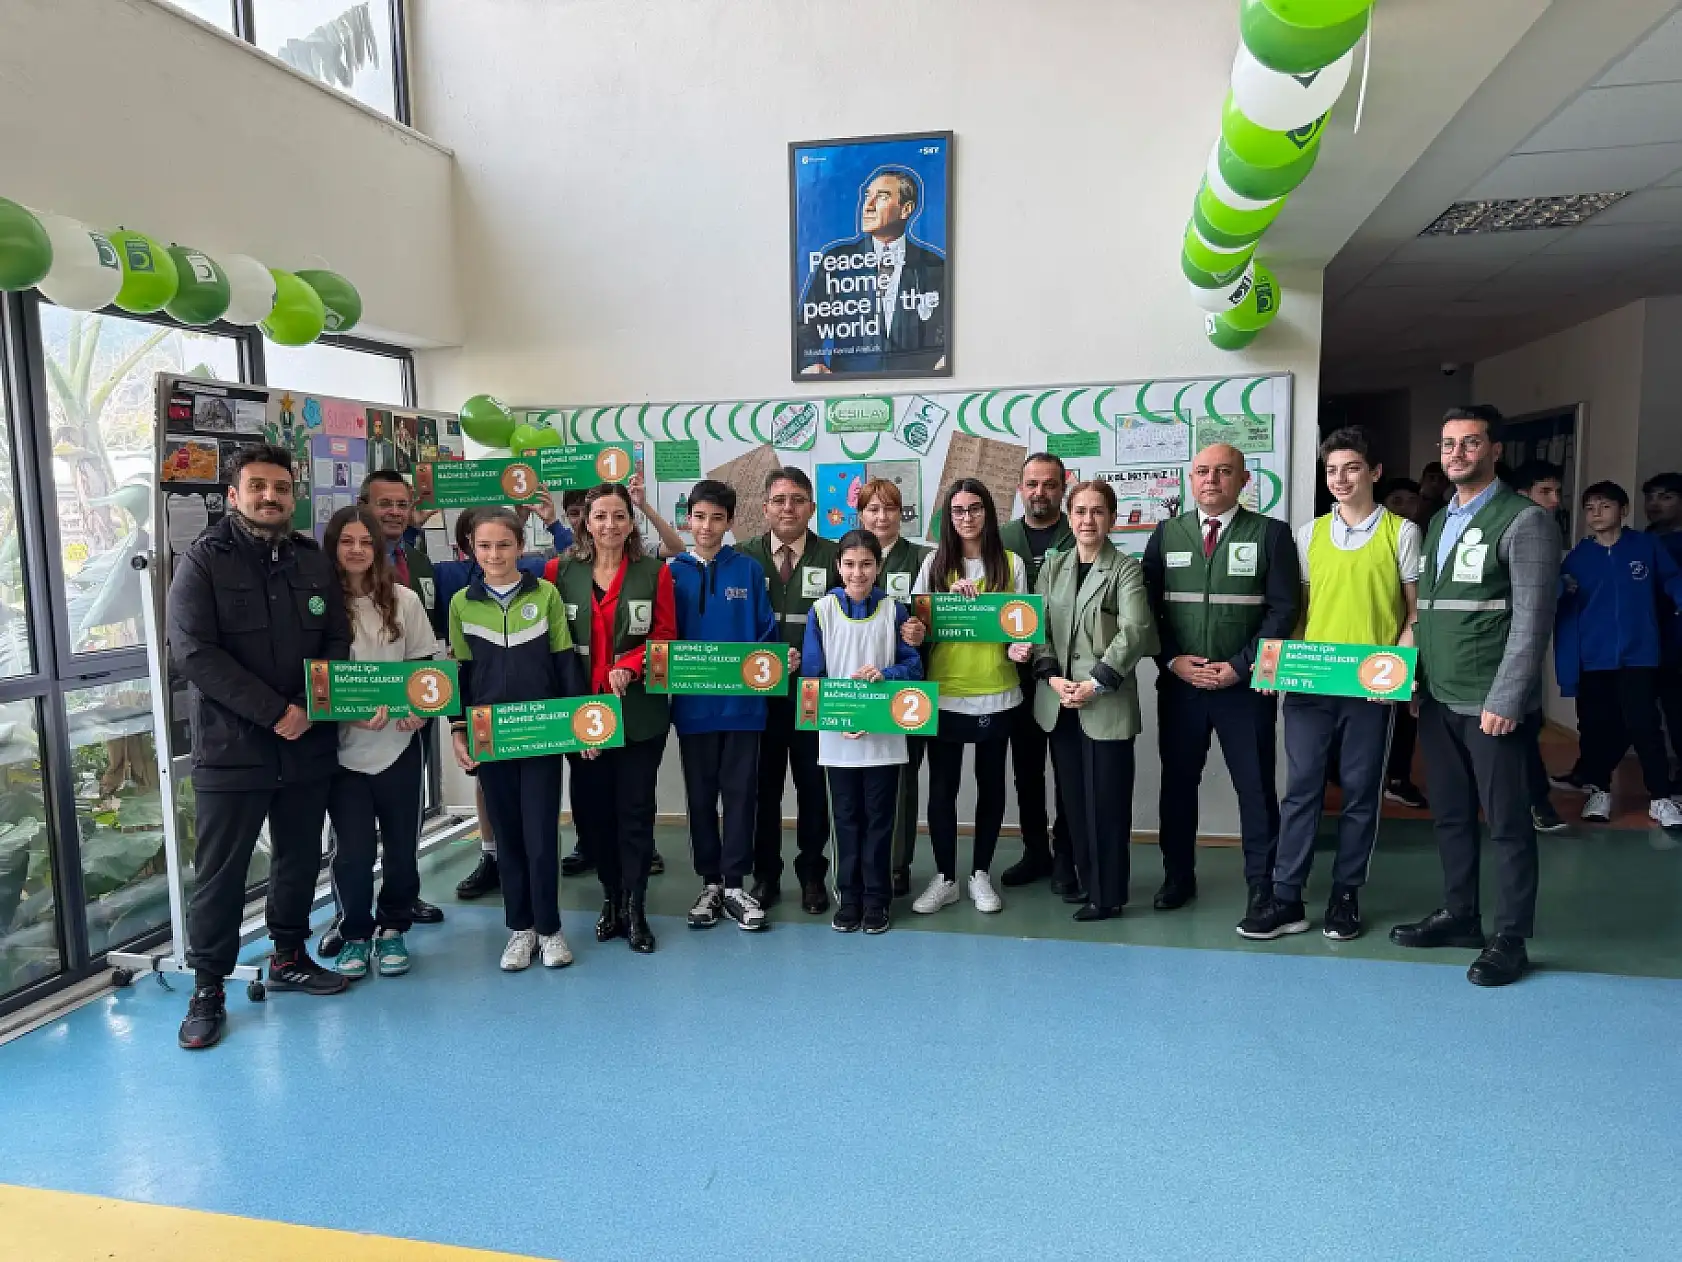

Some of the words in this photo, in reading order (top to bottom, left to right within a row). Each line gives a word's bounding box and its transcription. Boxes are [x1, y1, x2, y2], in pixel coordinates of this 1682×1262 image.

[810, 251, 877, 273] Peace
[882, 248, 906, 266] at
[826, 272, 889, 294] home
[804, 298, 871, 324] peace
[876, 290, 895, 313] in
[900, 288, 939, 310] the
[817, 314, 880, 339] world
[604, 454, 617, 476] 1
[512, 469, 527, 494] 3
[1008, 607, 1024, 632] 1
[963, 628, 978, 637] TL
[754, 656, 771, 684] 3
[1371, 659, 1394, 686] 2
[420, 674, 440, 704] 3
[902, 694, 920, 722] 2
[585, 709, 605, 737] 3
